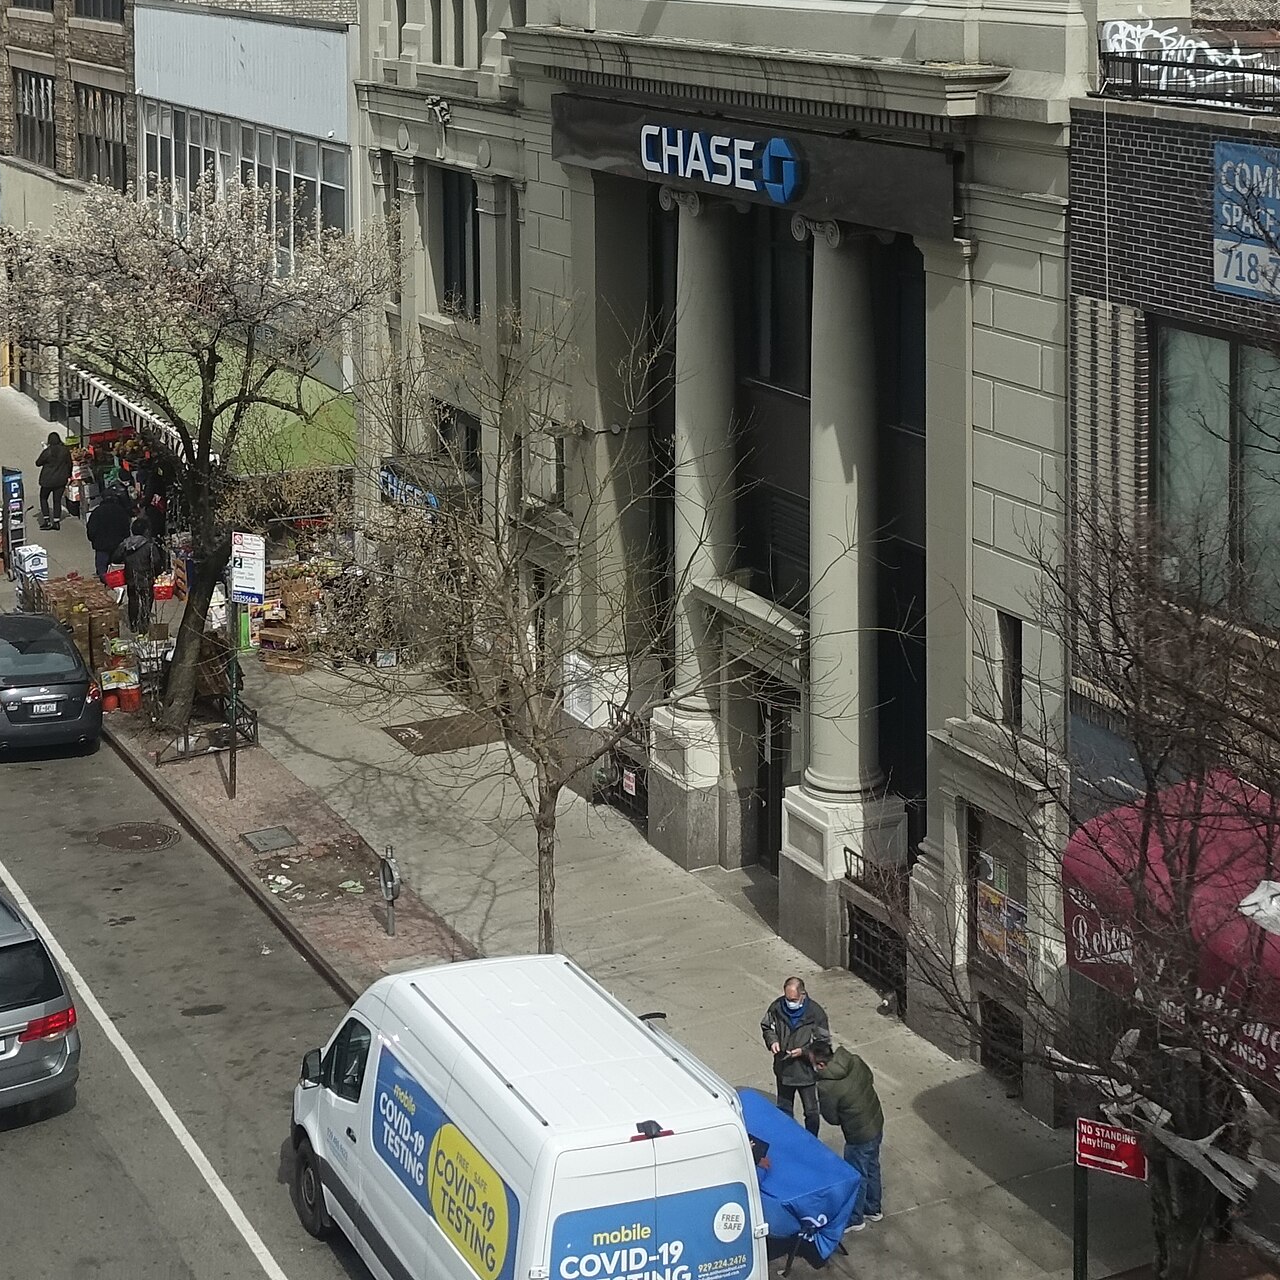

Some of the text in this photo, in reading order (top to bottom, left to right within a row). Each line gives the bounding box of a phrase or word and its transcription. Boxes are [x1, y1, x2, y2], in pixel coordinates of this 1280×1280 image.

[640, 124, 757, 192] CHASE
[1222, 201, 1275, 234] SPACE
[393, 1083, 417, 1116] mobile
[379, 1091, 425, 1157] COVID-19
[1081, 1123, 1137, 1145] NO STANDING
[382, 1120, 425, 1187] TESTING
[1081, 1134, 1116, 1151] Anytime
[456, 1150, 488, 1193] FREE SAFE
[435, 1148, 496, 1233] COVID-19
[440, 1185, 497, 1273] TESTING
[721, 1213, 741, 1223] FREE
[723, 1221, 742, 1231] SAFE
[593, 1223, 652, 1247] mobile
[559, 1240, 685, 1280] COVID-19
[698, 1254, 747, 1272] 929.224.2476
